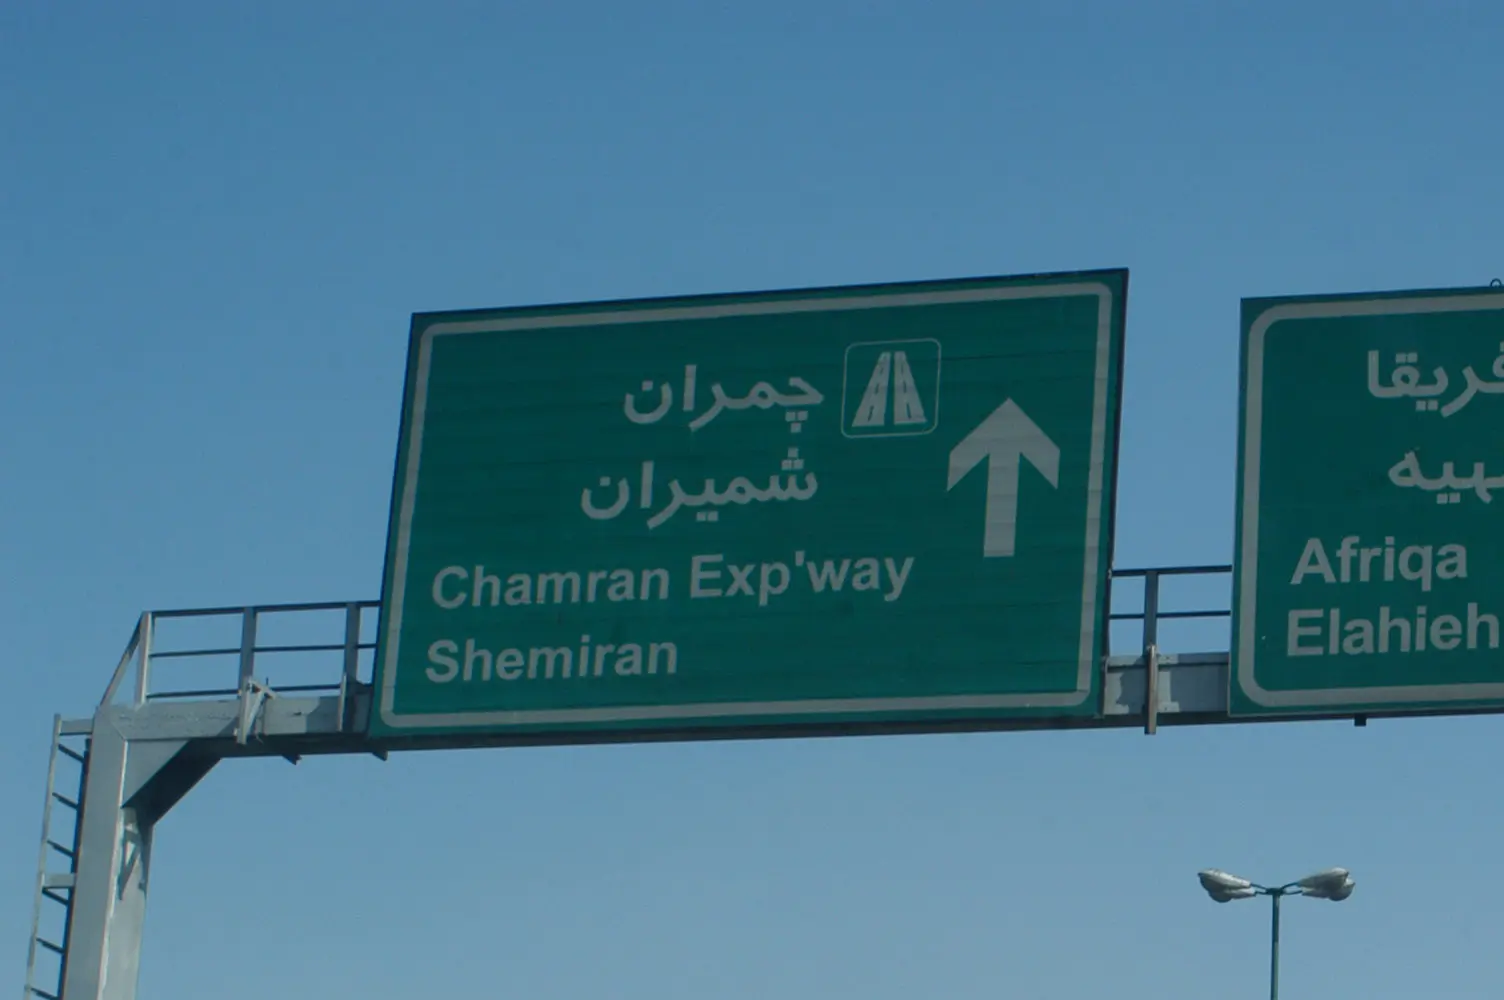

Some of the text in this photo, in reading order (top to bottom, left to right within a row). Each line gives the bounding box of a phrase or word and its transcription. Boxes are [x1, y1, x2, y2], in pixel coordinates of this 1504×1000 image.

[623, 365, 824, 434] چمران
[581, 448, 818, 530] شمیران
[431, 551, 914, 610] Chamran Exp'way
[1290, 535, 1468, 592] Afriqa
[425, 634, 677, 683] Shemiran
[1287, 602, 1500, 657] Elahieh
